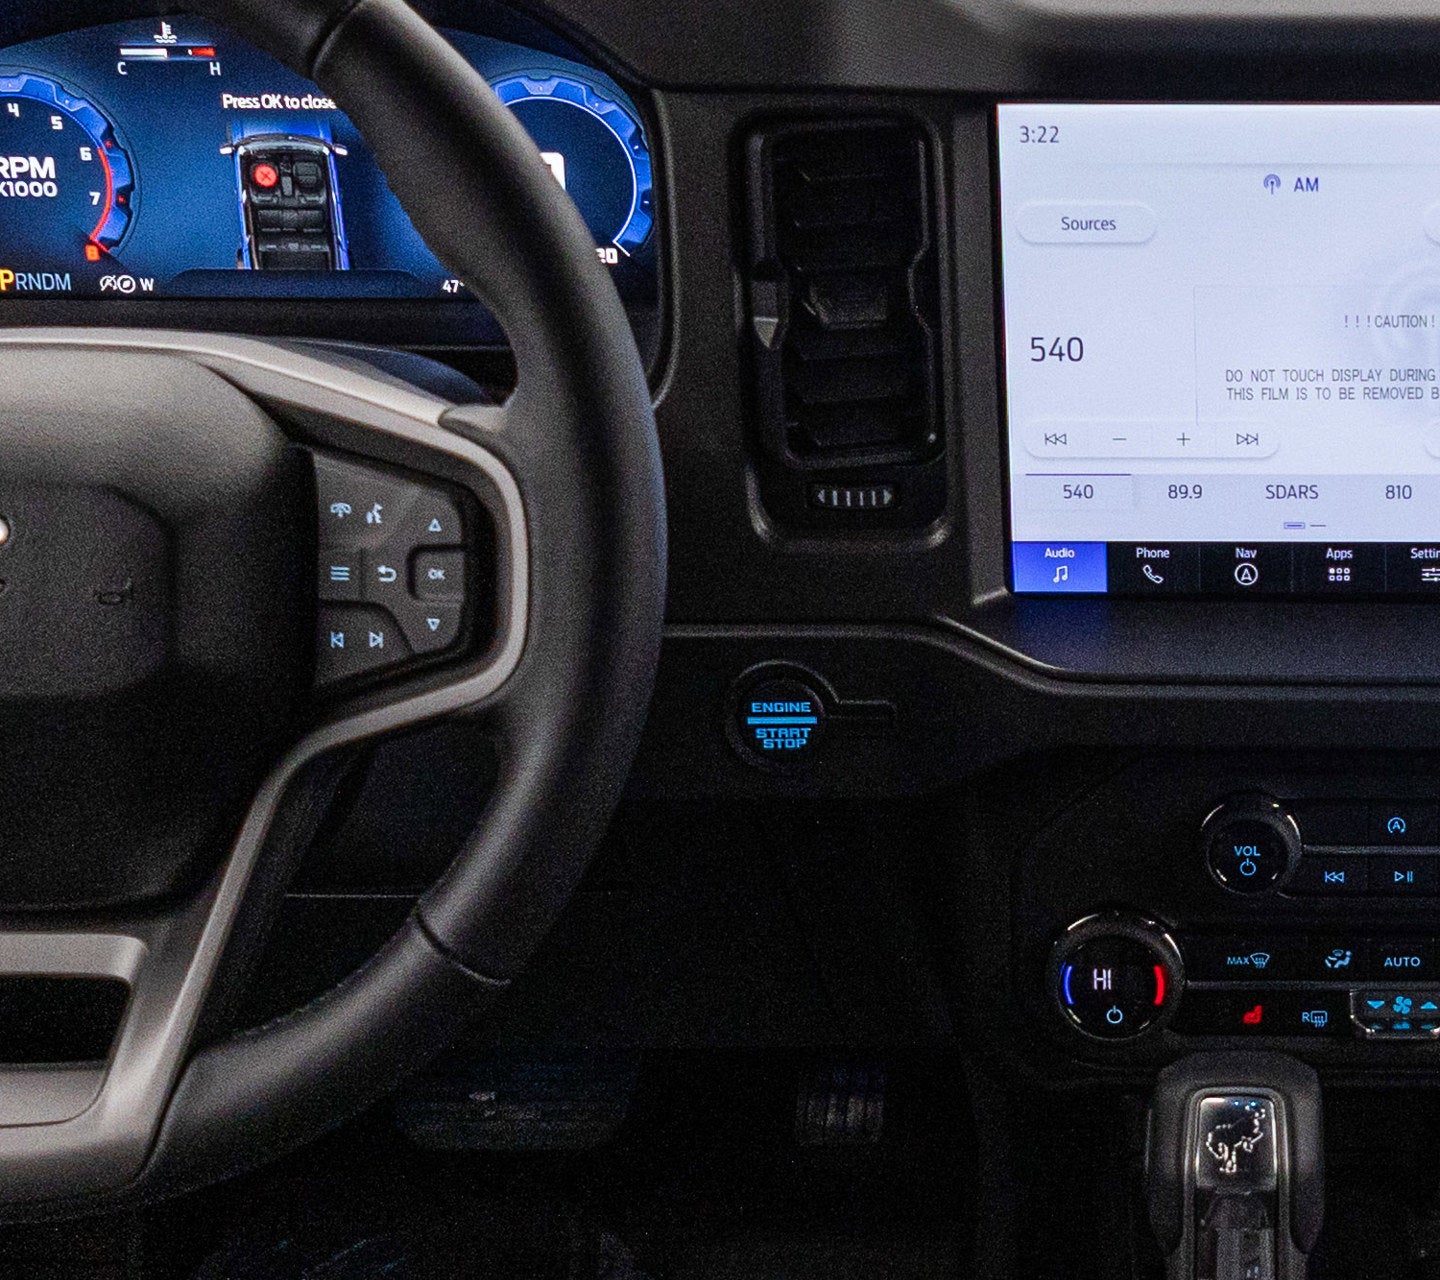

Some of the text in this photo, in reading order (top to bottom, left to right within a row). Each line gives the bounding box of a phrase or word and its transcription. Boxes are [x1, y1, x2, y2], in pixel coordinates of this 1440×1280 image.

[117, 61, 128, 75] C
[210, 62, 221, 76] H
[222, 93, 260, 109] Press
[261, 94, 283, 109] OK
[284, 95, 300, 109] to
[7, 103, 19, 117] 4
[51, 116, 63, 130] 5
[1020, 124, 1060, 144] 3:22
[80, 147, 92, 161] 6
[1293, 176, 1319, 192] AM
[90, 191, 101, 205] 7
[1060, 215, 1117, 232] Sources
[1030, 336, 1084, 363] 540
[1225, 369, 1244, 383] DO
[1250, 369, 1275, 383] NOT
[1282, 369, 1325, 383] TOUCH
[1332, 369, 1383, 382] DISPLAY
[1389, 369, 1436, 382] DURING
[1226, 387, 1254, 401] THIS
[1261, 387, 1290, 401] FILM
[1296, 387, 1308, 401] IS
[1315, 387, 1332, 401] TO
[1339, 387, 1356, 400] BE
[1363, 387, 1424, 400] REMOVED
[1062, 483, 1095, 500] 540
[1167, 483, 1203, 500] 89.9
[1265, 484, 1319, 500] SDARS
[1384, 484, 1413, 500] 810
[1044, 547, 1076, 559] Audio
[1135, 546, 1170, 559] Phone
[1235, 547, 1258, 559] Nav
[1325, 547, 1353, 561] Apps
[427, 567, 445, 580] OK
[750, 702, 812, 714] ENGINE
[755, 727, 812, 739] START
[762, 738, 808, 749] STOP
[1233, 845, 1261, 857] VOL
[1226, 956, 1250, 965] MAX
[1383, 956, 1422, 968] AUTO
[1092, 968, 1112, 990] HI
